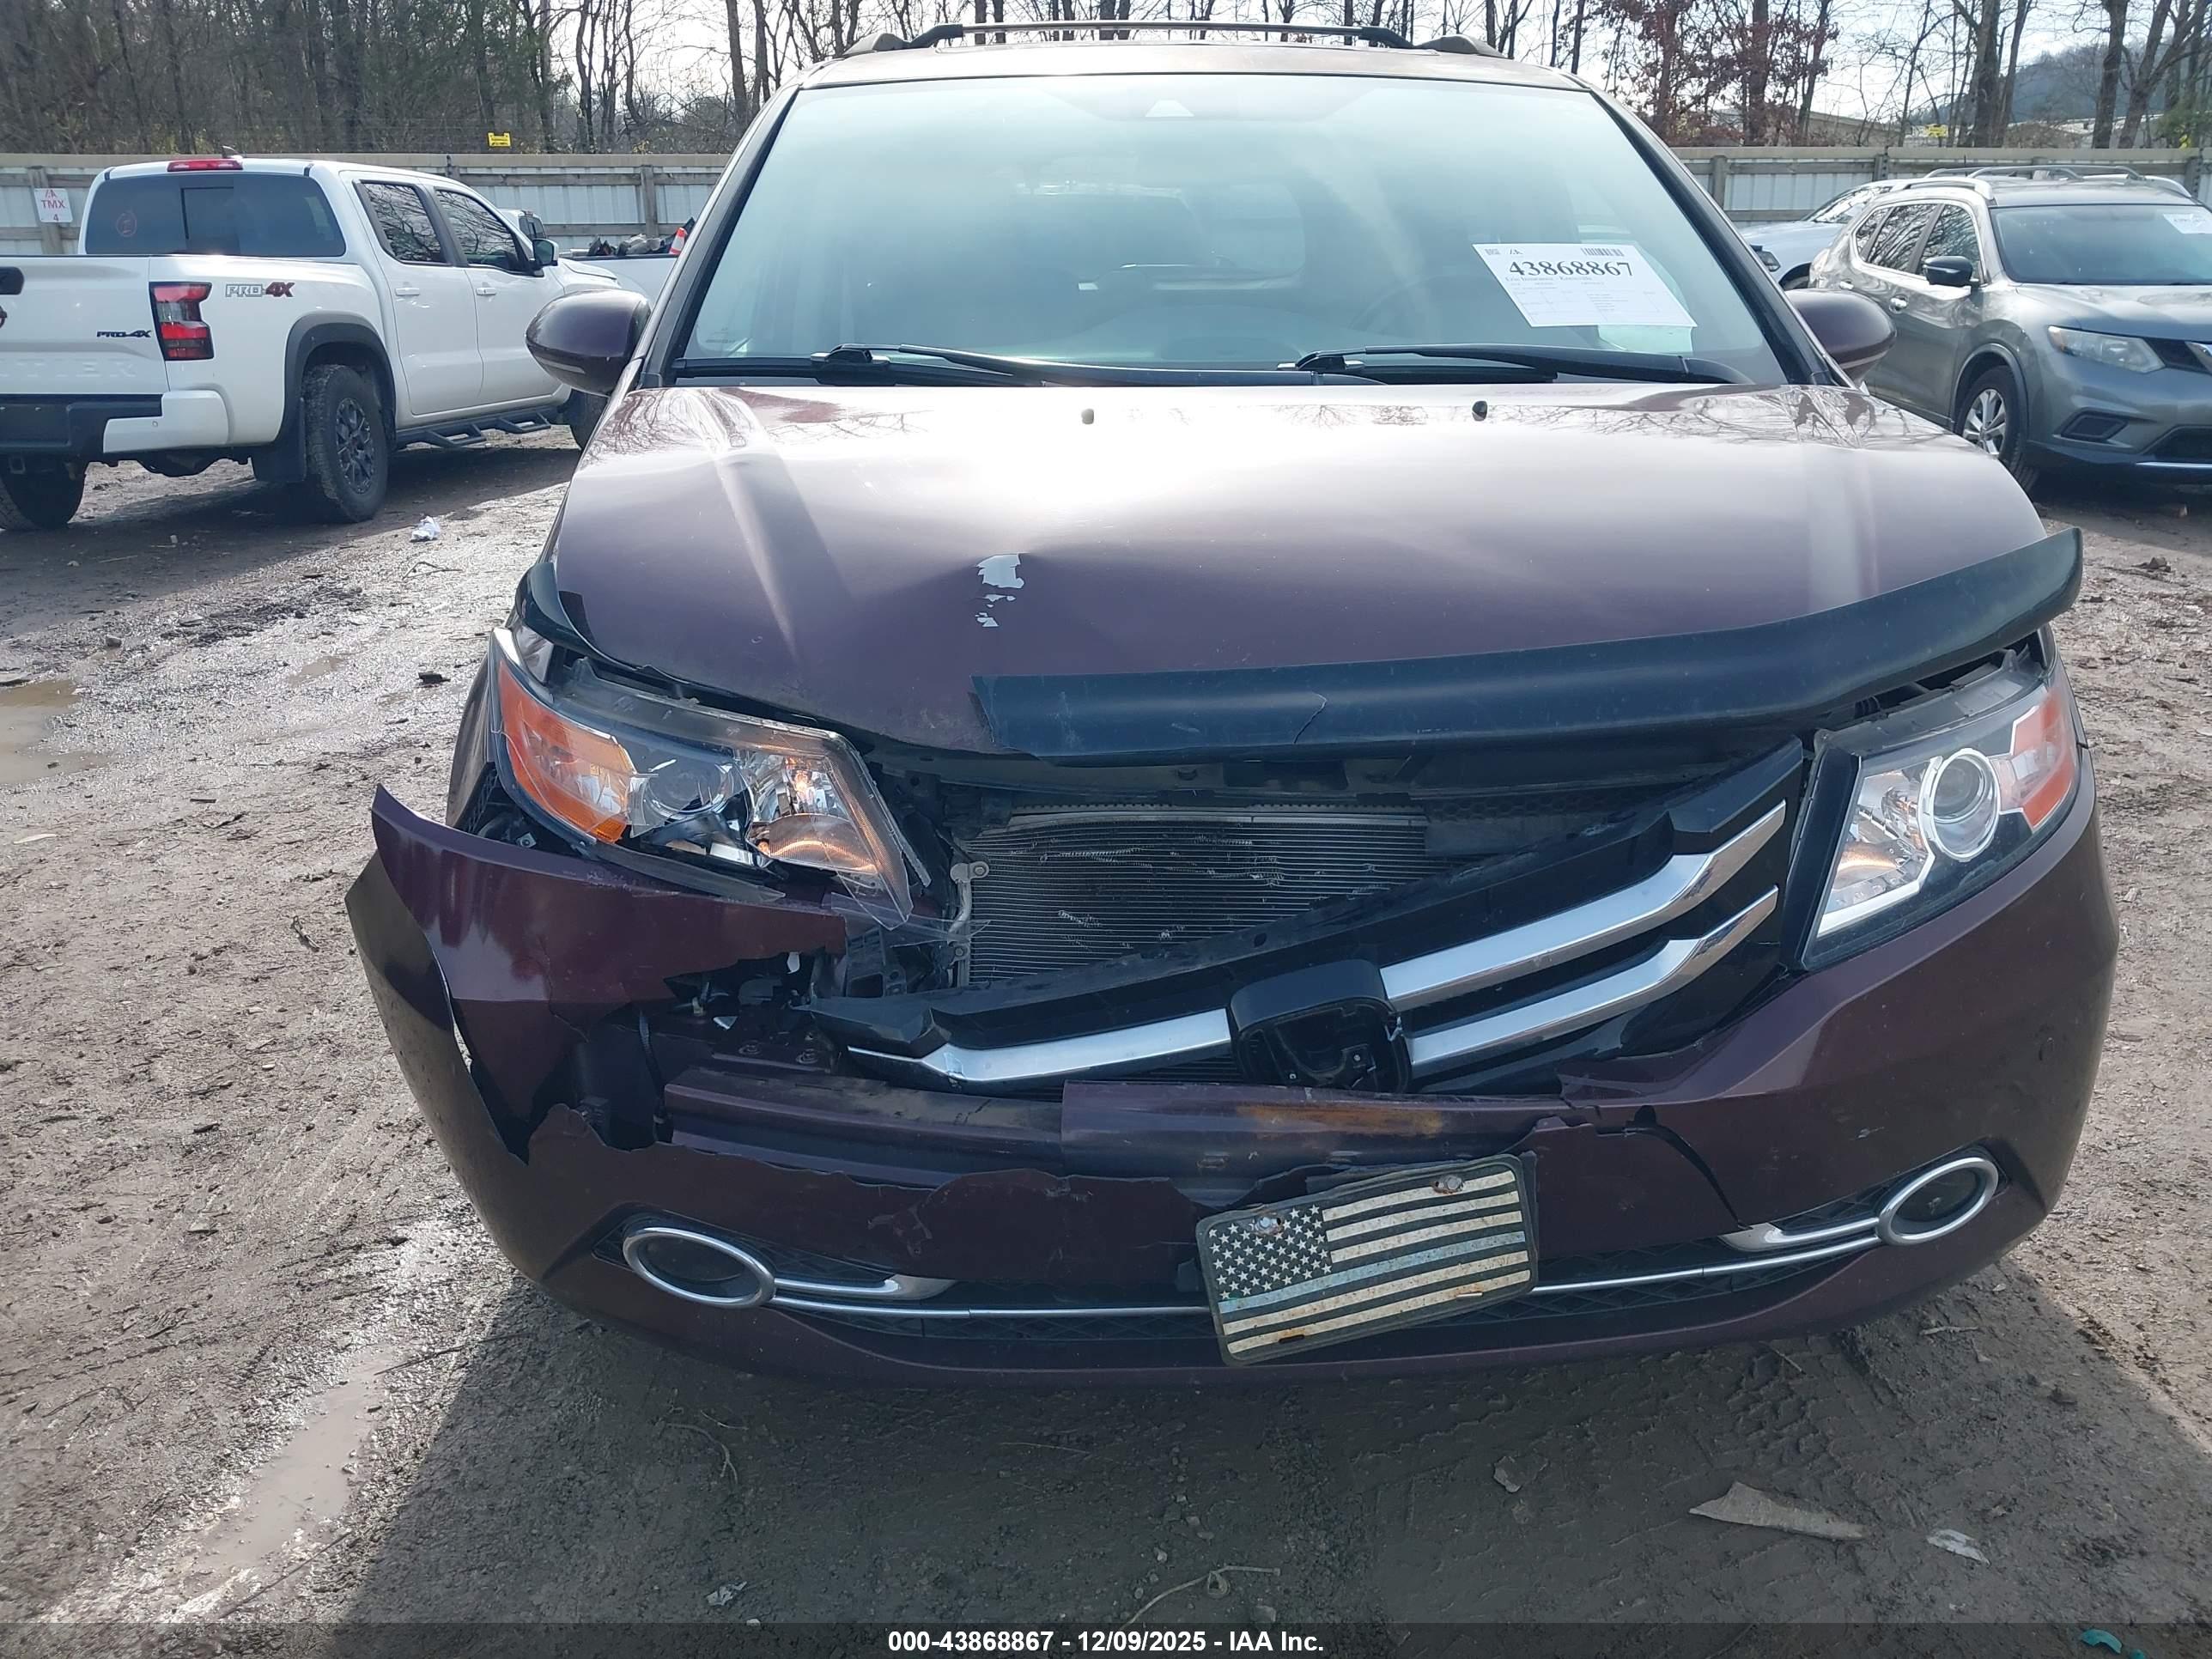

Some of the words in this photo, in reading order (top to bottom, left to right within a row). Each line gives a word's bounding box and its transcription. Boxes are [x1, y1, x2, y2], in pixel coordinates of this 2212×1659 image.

[40, 199, 65, 209] TMX
[53, 213, 59, 222] 4
[1509, 260, 1634, 276] 43868867
